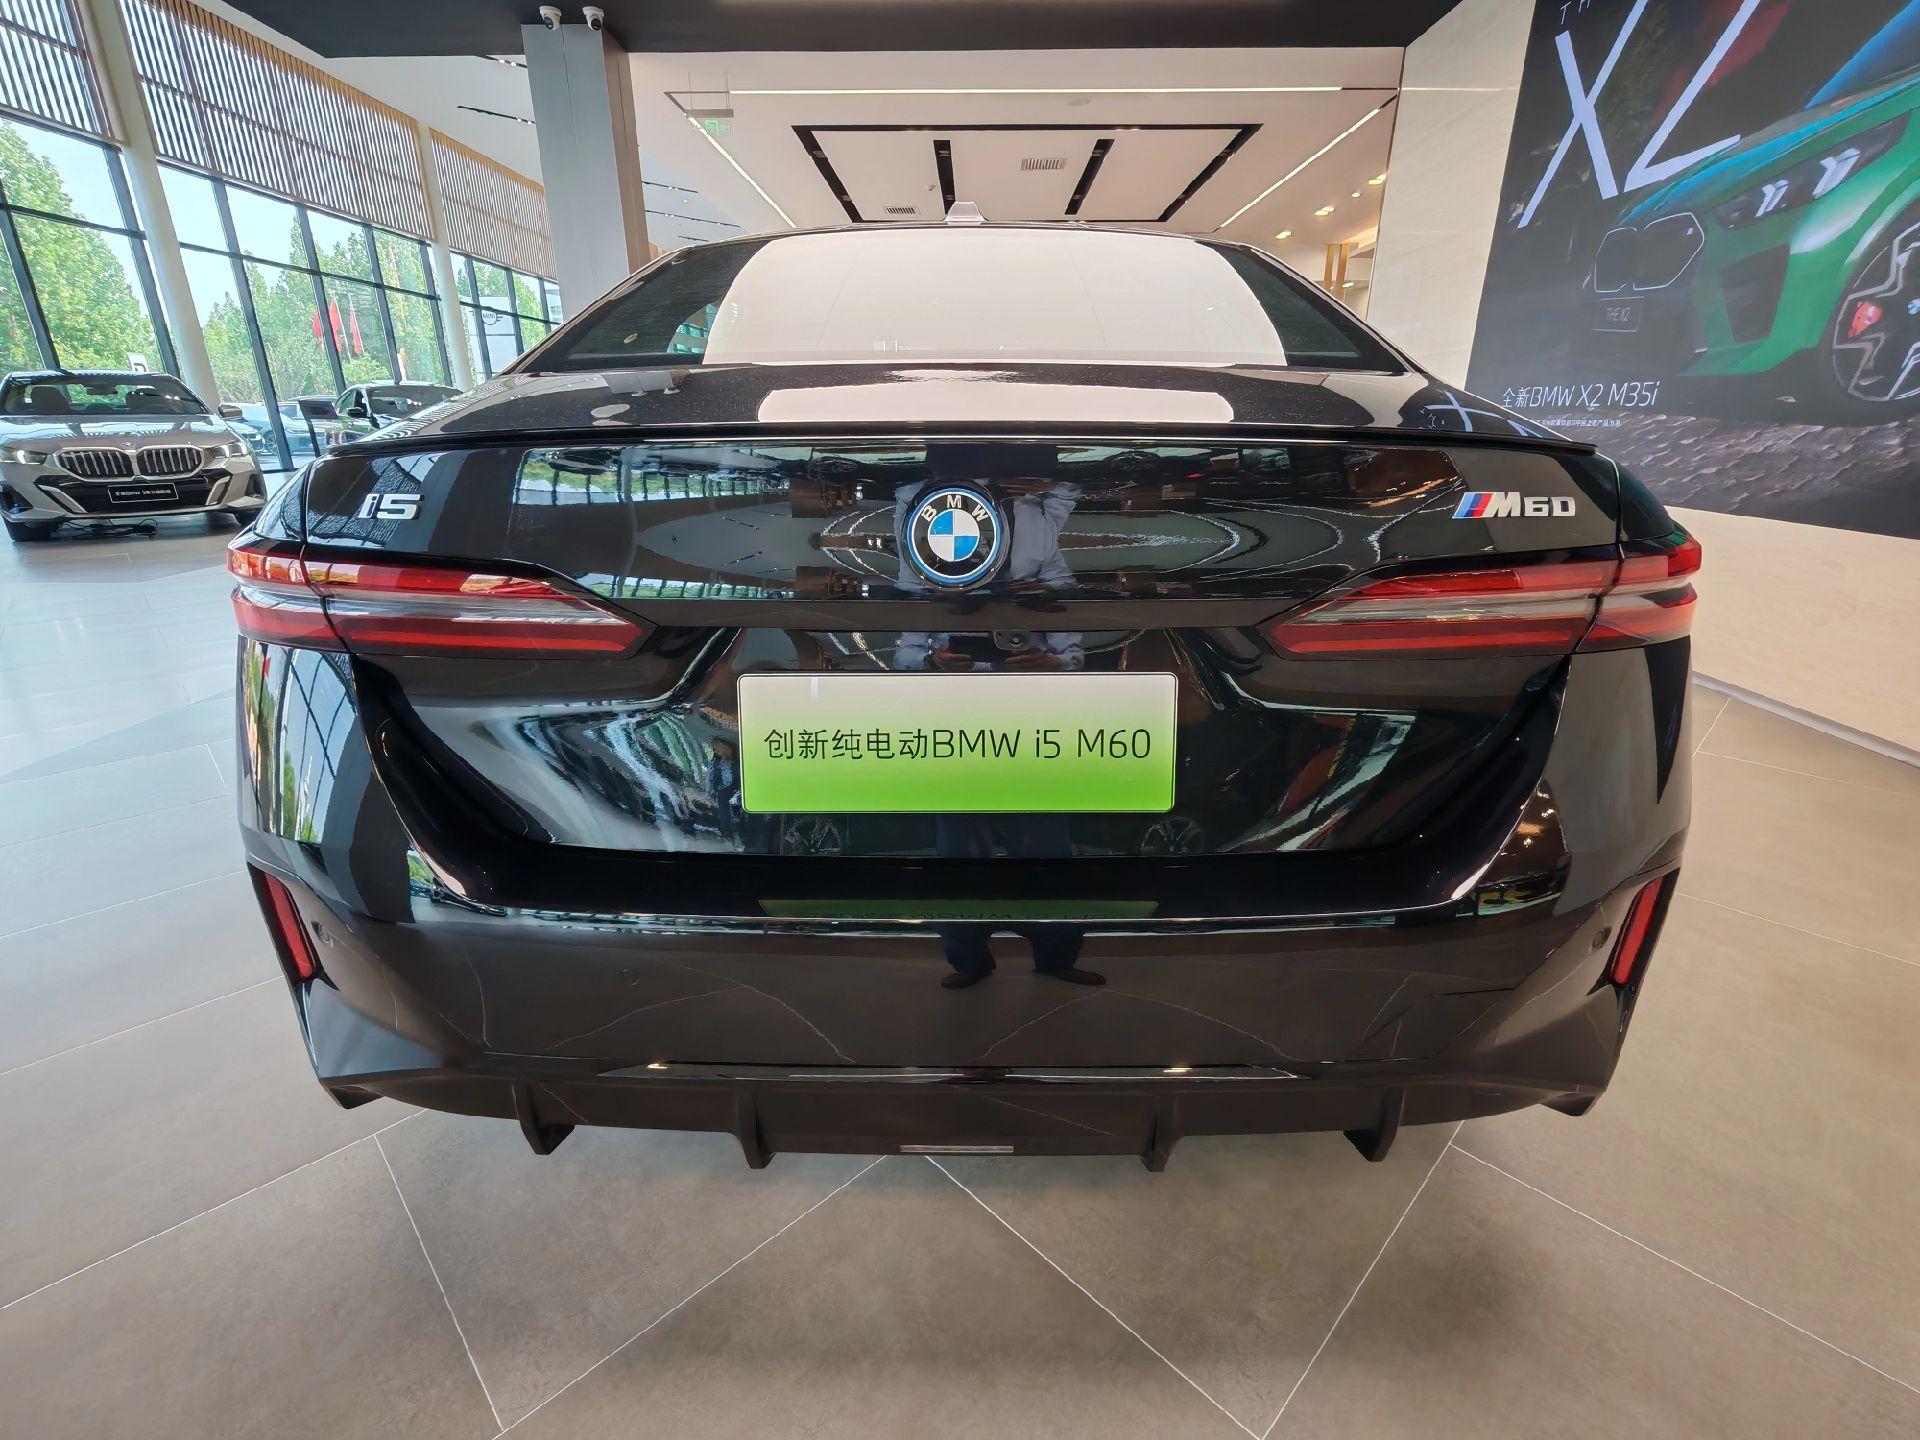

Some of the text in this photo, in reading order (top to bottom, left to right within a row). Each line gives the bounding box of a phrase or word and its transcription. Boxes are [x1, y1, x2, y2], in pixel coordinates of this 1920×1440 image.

[1502, 380, 1660, 408] 全新BMW X2 M35i
[358, 493, 421, 520] i5
[920, 494, 989, 523] BMW
[1479, 491, 1576, 518] M60
[763, 729, 1151, 760] 创新纯电动BMW i5 M60
